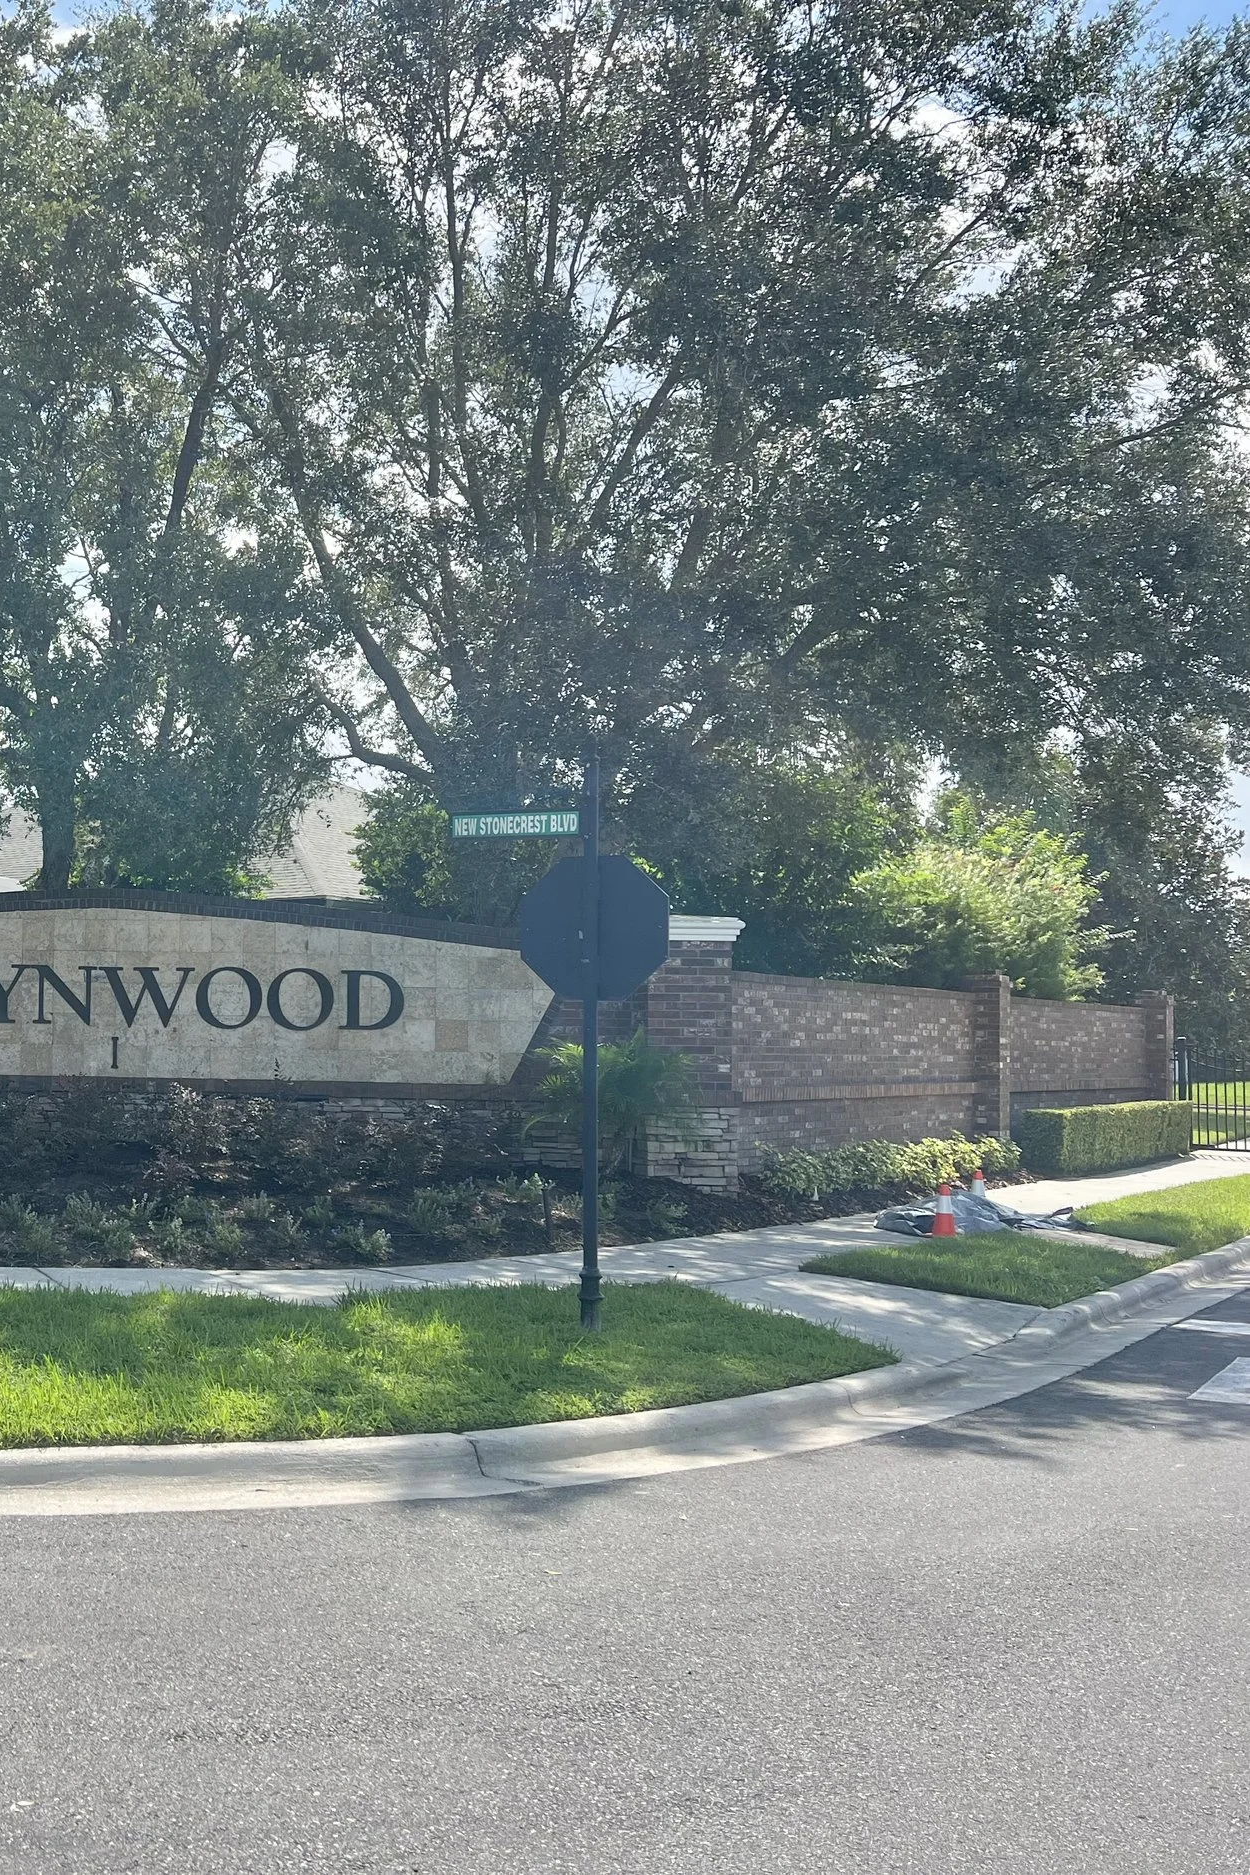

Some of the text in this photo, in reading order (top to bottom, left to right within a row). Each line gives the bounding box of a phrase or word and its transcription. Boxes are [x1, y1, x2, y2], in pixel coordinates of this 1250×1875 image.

[454, 813, 578, 836] NEW STONECREST BLVD
